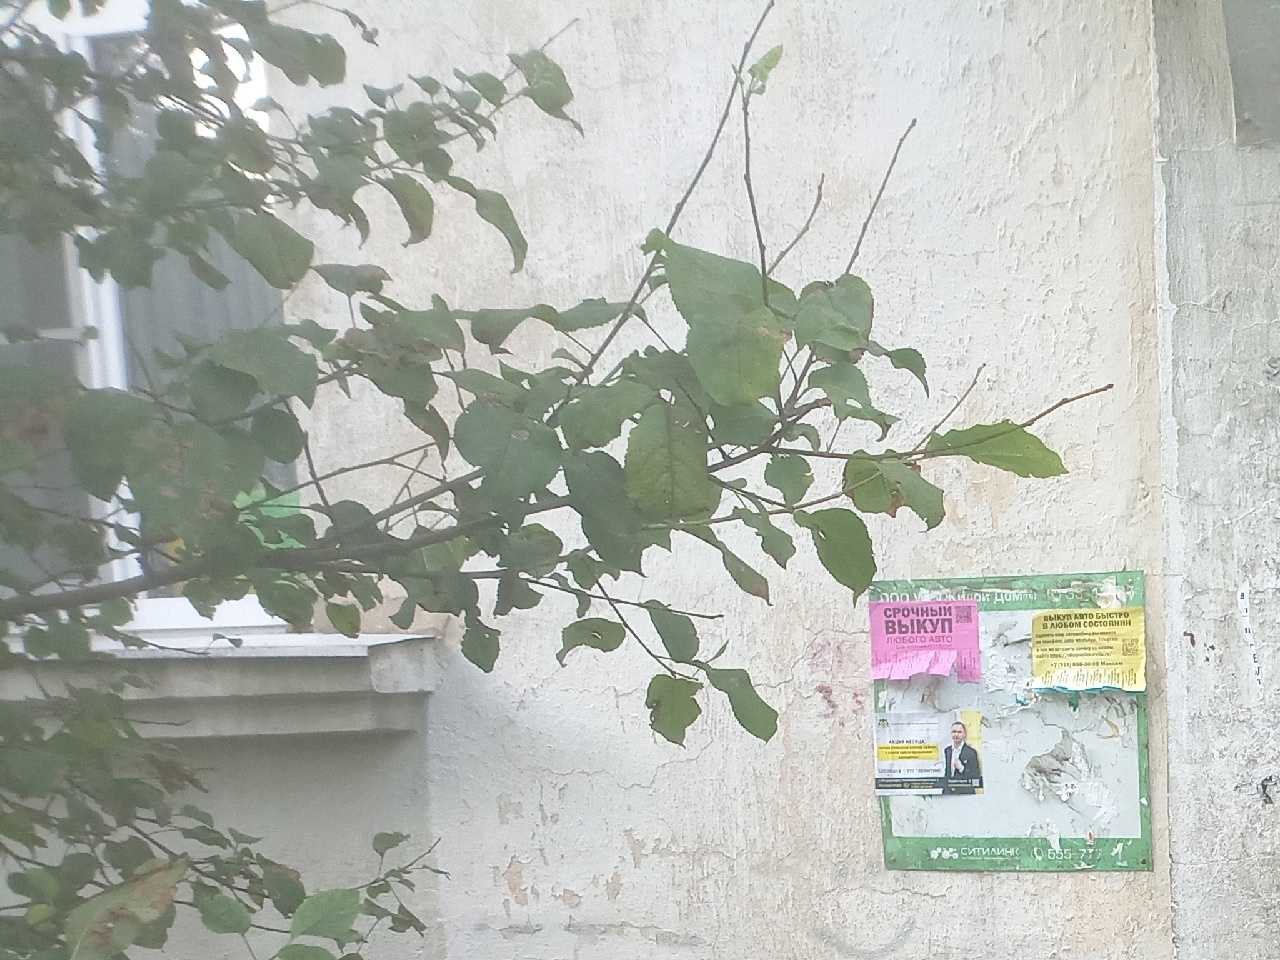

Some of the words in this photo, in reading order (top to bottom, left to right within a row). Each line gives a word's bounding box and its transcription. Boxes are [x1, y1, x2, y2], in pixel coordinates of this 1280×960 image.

[883, 605, 952, 619] СРОЧНЫЙ
[1043, 613, 1072, 622] ВЫКУП
[1073, 612, 1094, 620] АВТО
[1095, 611, 1130, 620] БЫСТРО
[885, 618, 953, 635] ВЫКУП
[1050, 621, 1082, 629] ЛЮБОМ
[1083, 619, 1132, 628] СОСТОЯНИИ
[887, 635, 927, 644] ЛЮБОГО
[929, 635, 953, 643] АВТО
